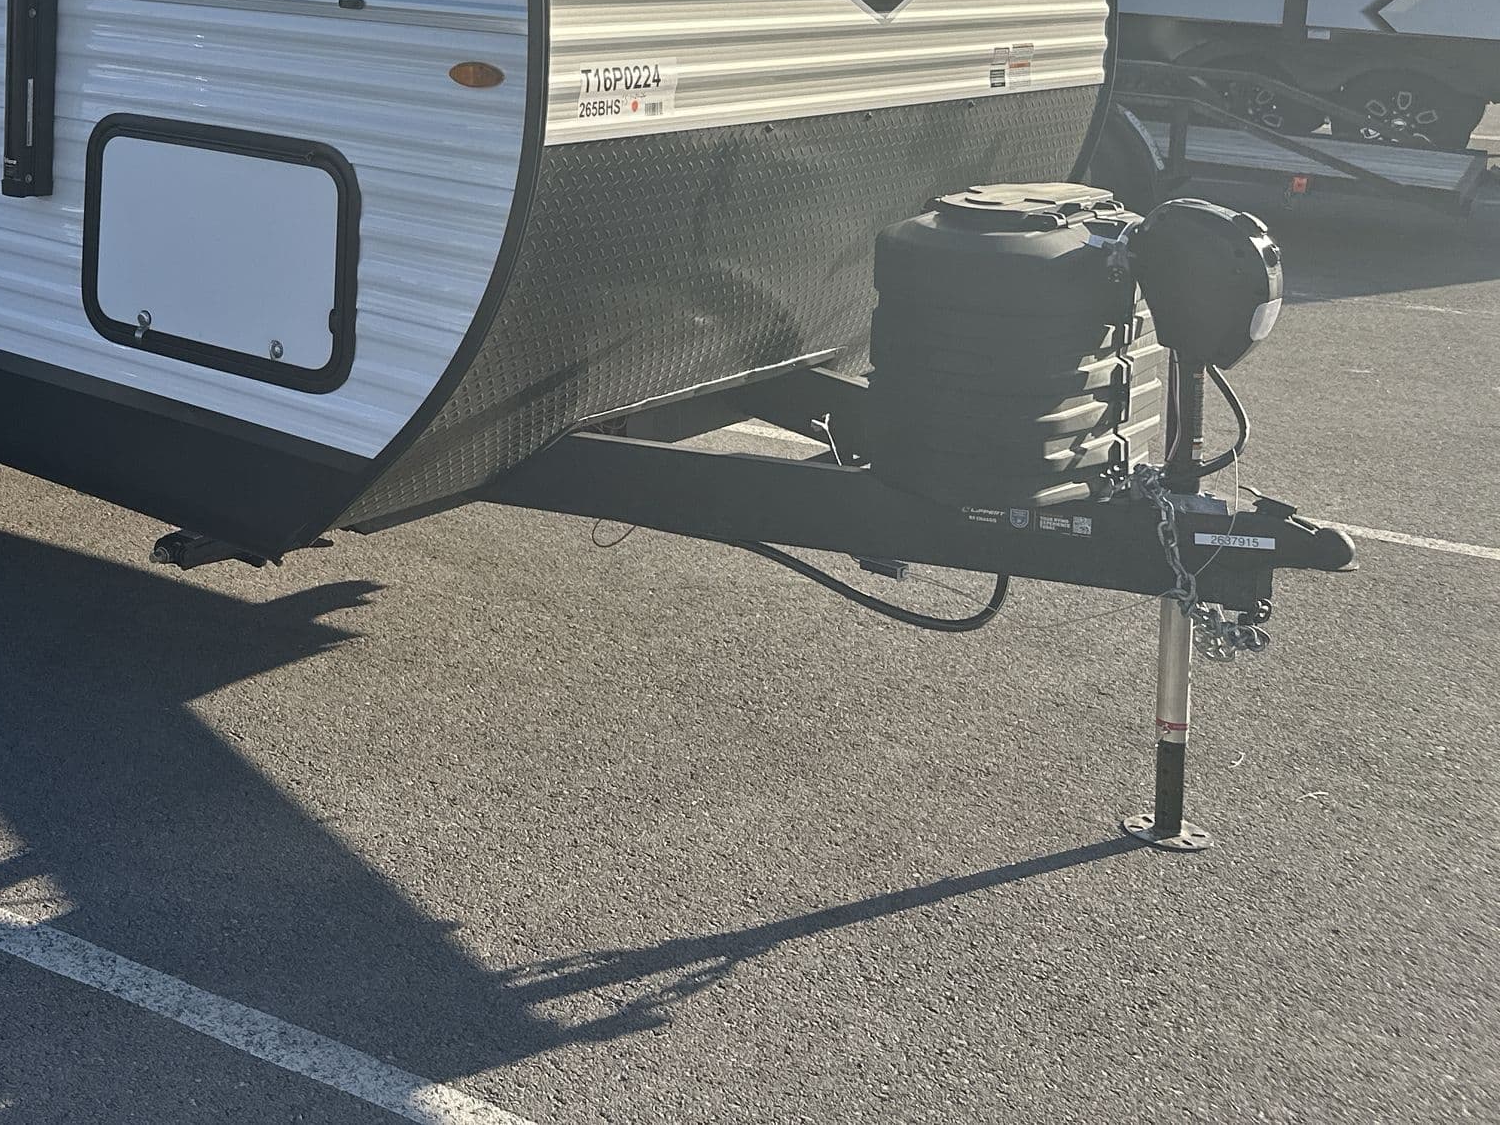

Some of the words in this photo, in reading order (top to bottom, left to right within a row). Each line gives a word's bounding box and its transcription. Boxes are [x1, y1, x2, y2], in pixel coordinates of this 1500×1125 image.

[581, 64, 662, 93] T16P0224
[579, 99, 621, 118] 265BHS
[1210, 535, 1260, 548] 2637915
